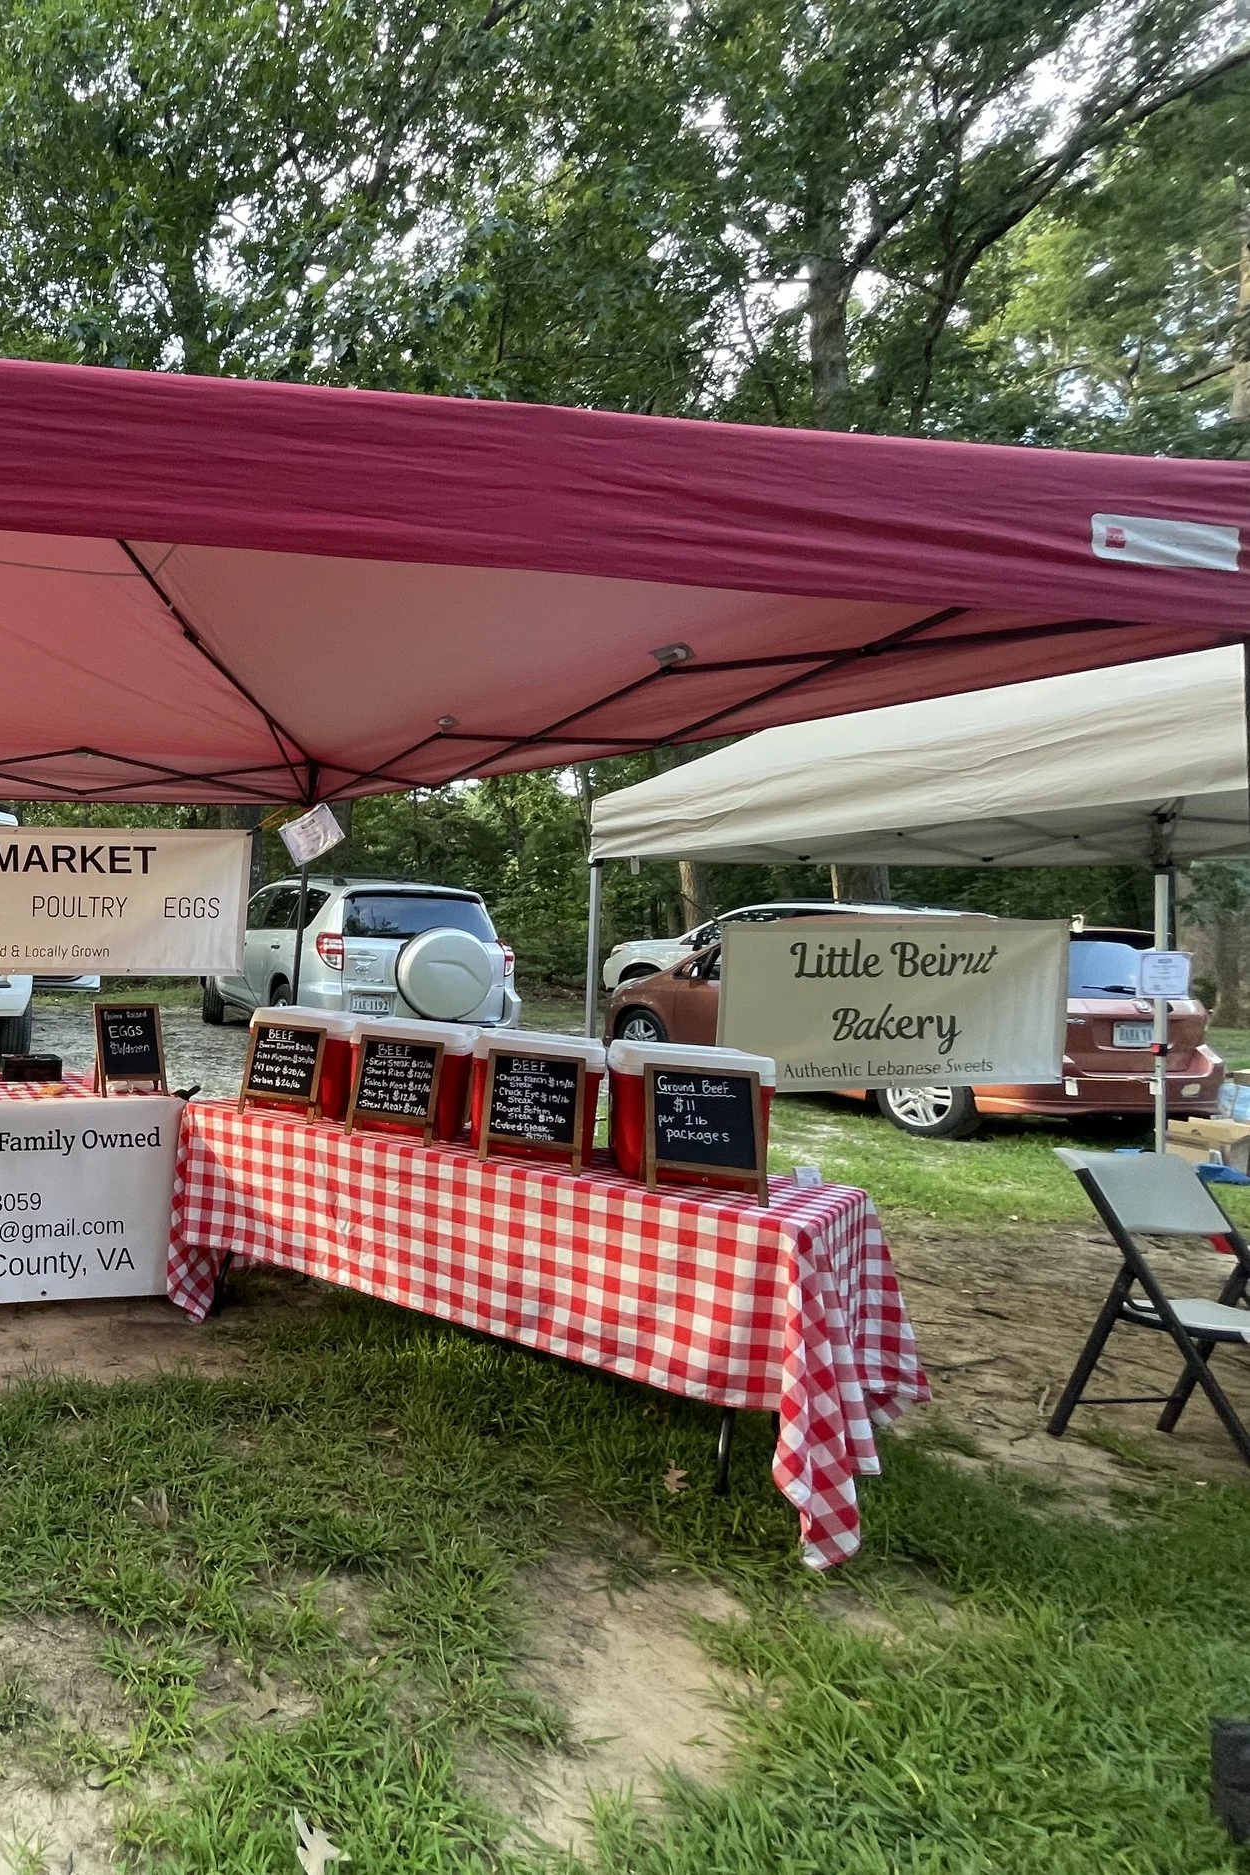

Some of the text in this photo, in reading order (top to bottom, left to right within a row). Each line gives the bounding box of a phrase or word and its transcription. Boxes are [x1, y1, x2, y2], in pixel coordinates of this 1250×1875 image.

[32, 896, 128, 918] POULTRY
[164, 897, 221, 919] EGGS
[11, 946, 20, 958] &
[25, 945, 68, 960] Locally
[71, 944, 110, 958] Grown
[790, 938, 998, 979] Little Beirut
[108, 1026, 143, 1039] EGGS
[268, 1028, 295, 1040] BEEF
[832, 1003, 962, 1055] Bakery
[378, 1044, 412, 1056] BEEF
[388, 1060, 410, 1068] Steak
[512, 1060, 547, 1071] BEEF
[784, 1058, 993, 1079] Authentic Lebanese Sweets
[366, 1067, 386, 1076] Short
[658, 1076, 730, 1094] Ground Beef
[378, 1090, 389, 1100] Fry
[499, 1087, 523, 1096] Chuck
[524, 1090, 540, 1099] Eye
[383, 1102, 403, 1111] Meat
[496, 1102, 521, 1113] Round
[673, 1096, 696, 1113] $11
[658, 1114, 675, 1127] per
[82, 1126, 162, 1149] Owned
[666, 1129, 730, 1144] packages
[97, 1248, 135, 1271] VA
